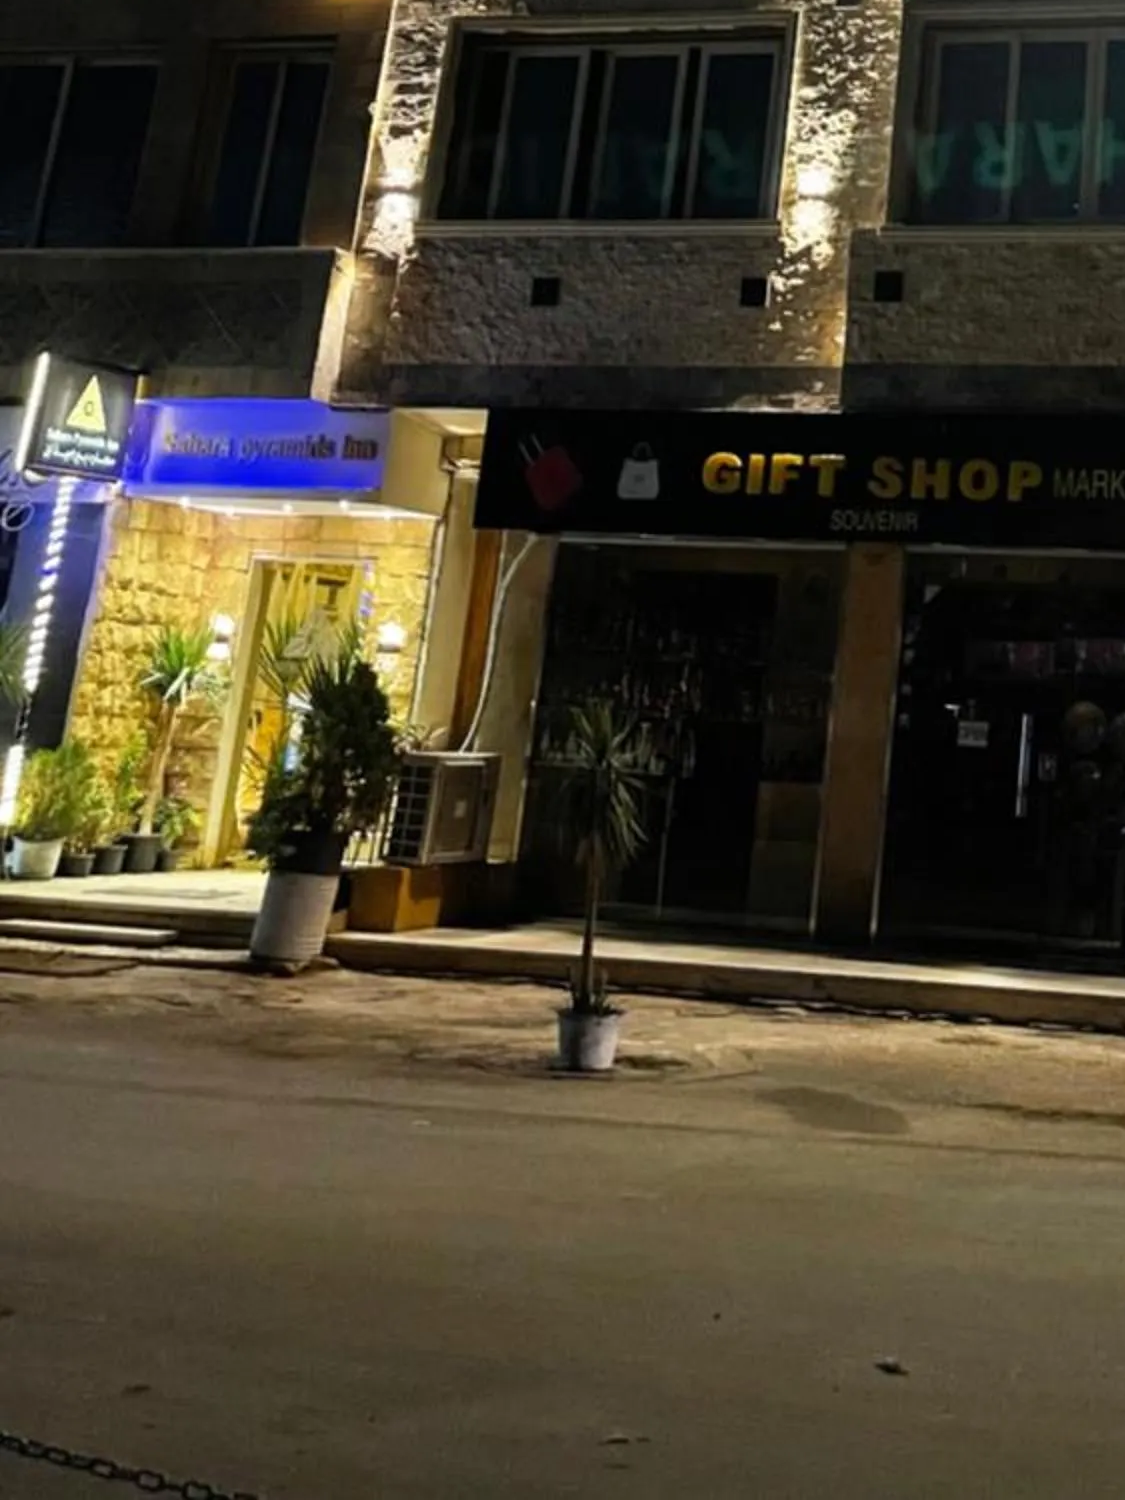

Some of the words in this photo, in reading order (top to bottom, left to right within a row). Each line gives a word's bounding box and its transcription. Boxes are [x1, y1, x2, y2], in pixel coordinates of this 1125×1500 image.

[701, 451, 846, 498] GIFT
[866, 456, 1043, 501] SHOP
[830, 508, 919, 532] SOUVENIR
